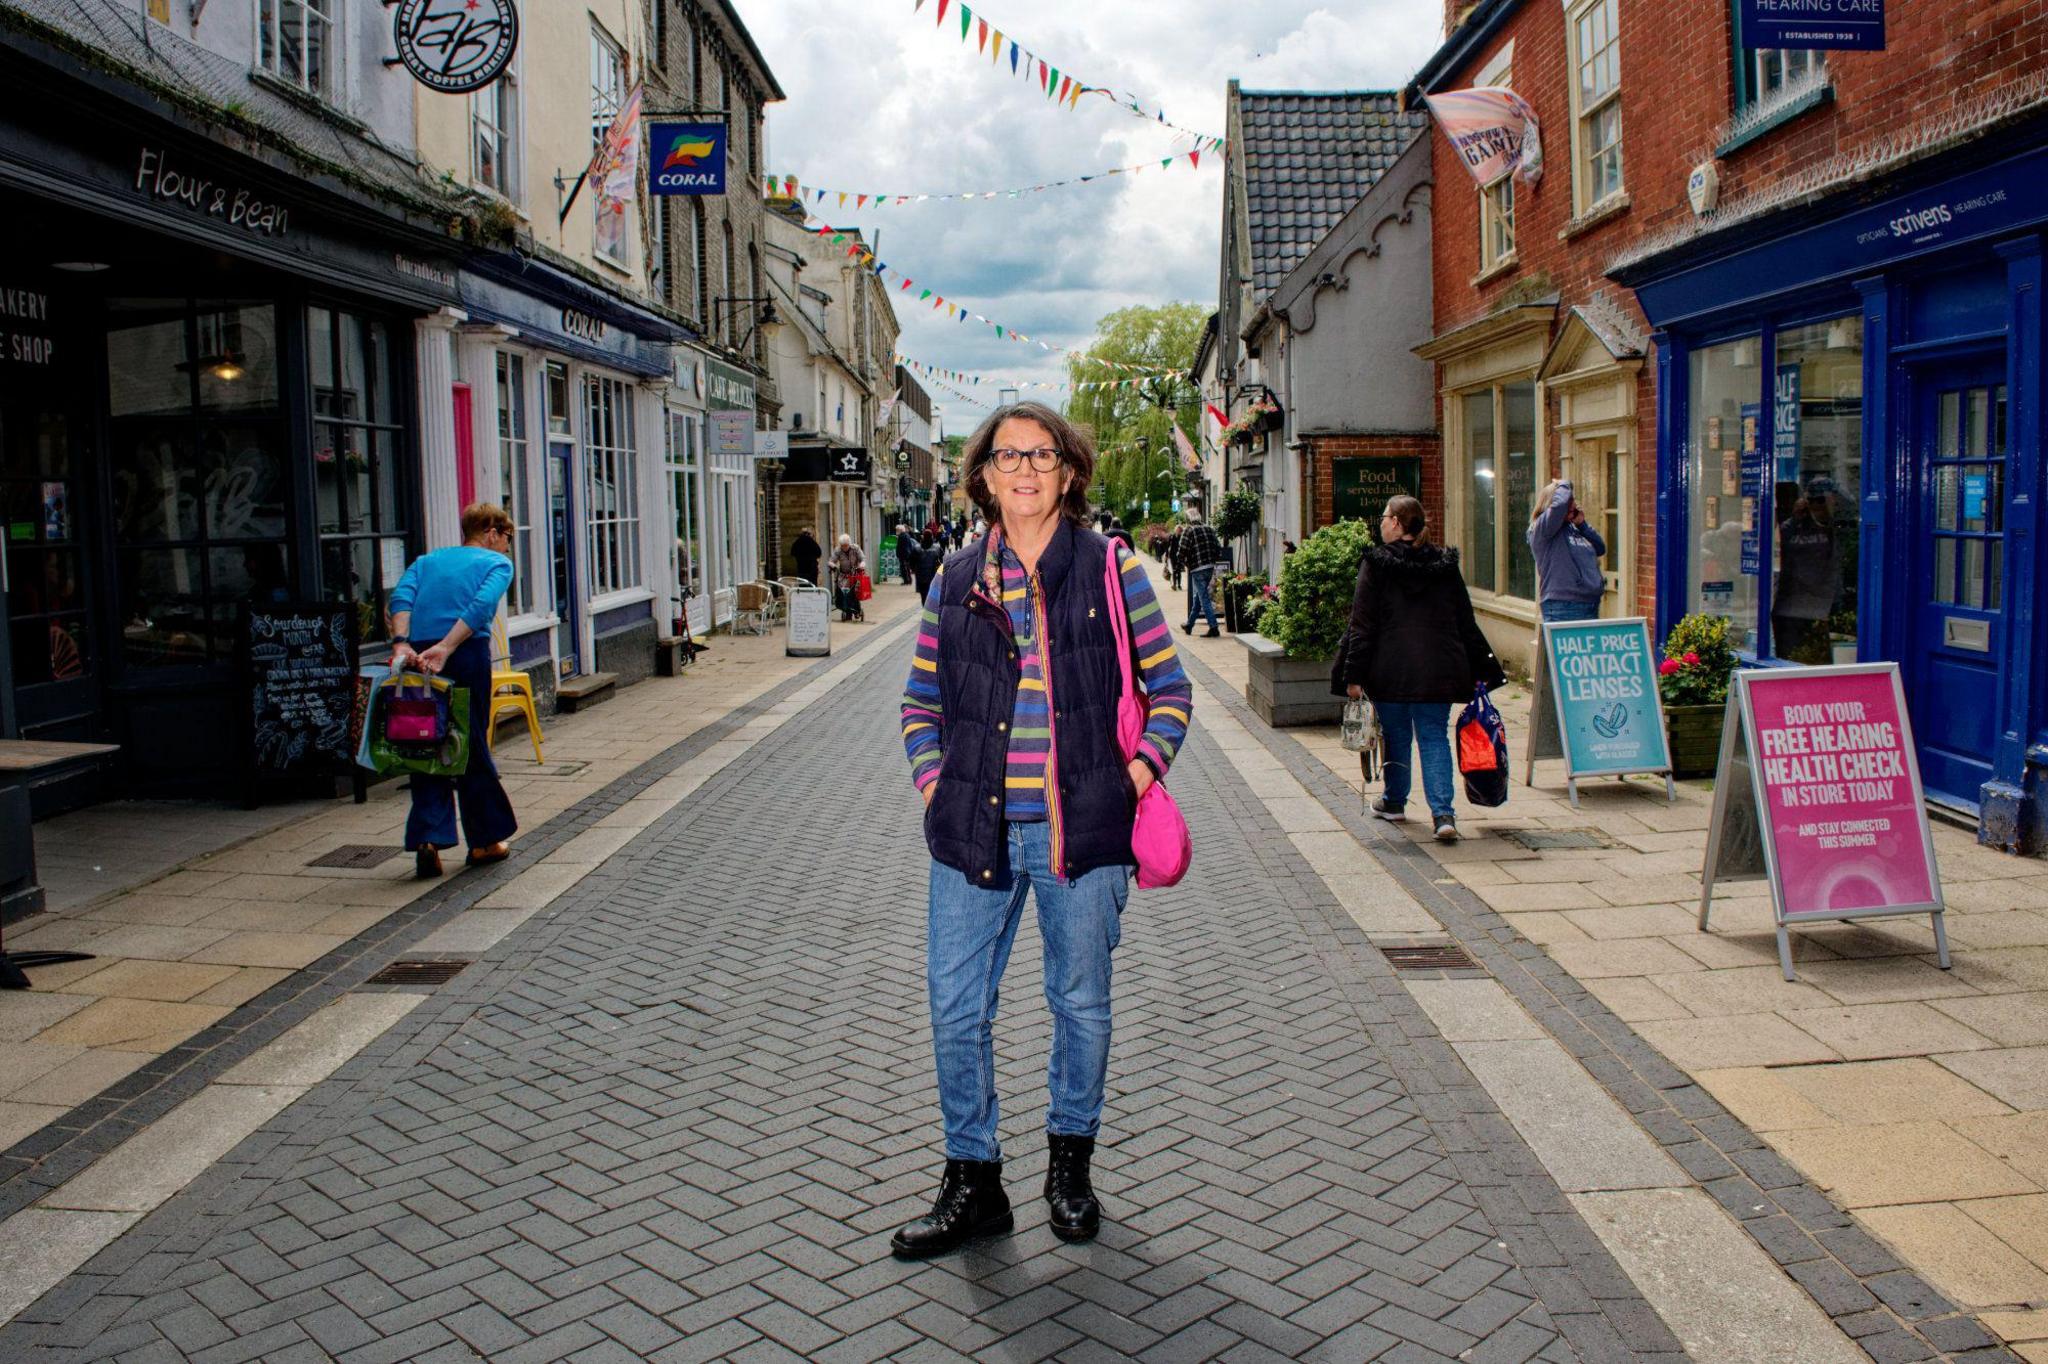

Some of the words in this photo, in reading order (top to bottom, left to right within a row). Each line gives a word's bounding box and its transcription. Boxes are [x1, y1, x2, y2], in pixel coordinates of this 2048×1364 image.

[1756, 0, 1831, 11] HEARING
[1837, 0, 1880, 12] CARE
[1785, 32, 1834, 40] ESTABLISHED
[424, 68, 473, 87] COFFEE
[473, 37, 509, 81] MAKING
[136, 148, 212, 206] Flour
[209, 188, 226, 213] &
[230, 187, 289, 234] Bean
[658, 174, 718, 186] CORAL
[1856, 226, 1889, 244] OPTICIANS
[1890, 203, 1952, 237] scrivens
[1953, 196, 1986, 214] HEARING
[1985, 190, 2008, 205] CARE
[12, 333, 53, 364] SHOP
[1359, 467, 1396, 483] Food
[1346, 484, 1380, 495] served
[282, 630, 312, 646] MONTH
[1556, 636, 1595, 655] HALF
[1600, 633, 1640, 652] PRICE
[1560, 652, 1642, 677] CONTACT
[1567, 675, 1643, 701] LENSES
[1783, 703, 1825, 725] BOOK
[1825, 702, 1866, 723] YOUR
[1761, 727, 1810, 755] FREE
[1810, 722, 1896, 752] HEARING
[1763, 754, 1839, 785] HEALTH
[1840, 750, 1905, 780] CHECK
[1782, 787, 1799, 807] IN
[1800, 783, 1847, 806] STORE
[1848, 780, 1894, 802] TODAY
[1799, 823, 1817, 836] AND
[1818, 822, 1840, 835] STAY
[1841, 819, 1890, 833] CONNECTED
[1817, 836, 1839, 849] THIS
[1839, 834, 1876, 847] SUMMER
